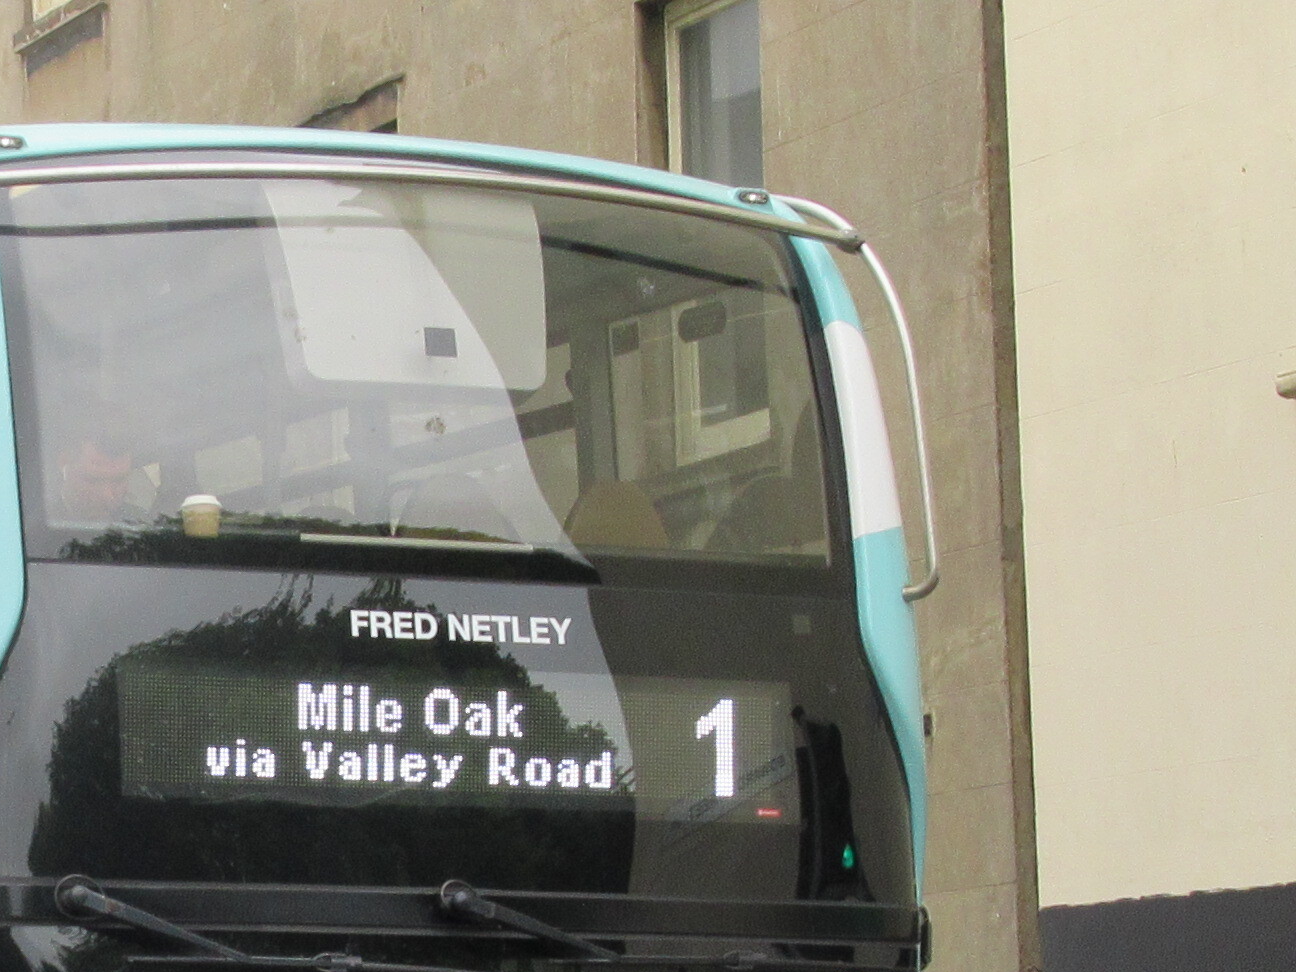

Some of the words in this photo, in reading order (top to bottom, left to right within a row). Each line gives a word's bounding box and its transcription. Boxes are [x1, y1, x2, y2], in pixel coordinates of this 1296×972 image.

[350, 609, 438, 641] FRED
[447, 612, 572, 645] NETLEY
[297, 682, 403, 734] Mile
[424, 687, 525, 738] Oak
[205, 738, 276, 779] via
[301, 741, 463, 788] Valley
[488, 746, 612, 790] Road
[695, 698, 735, 797] 1
